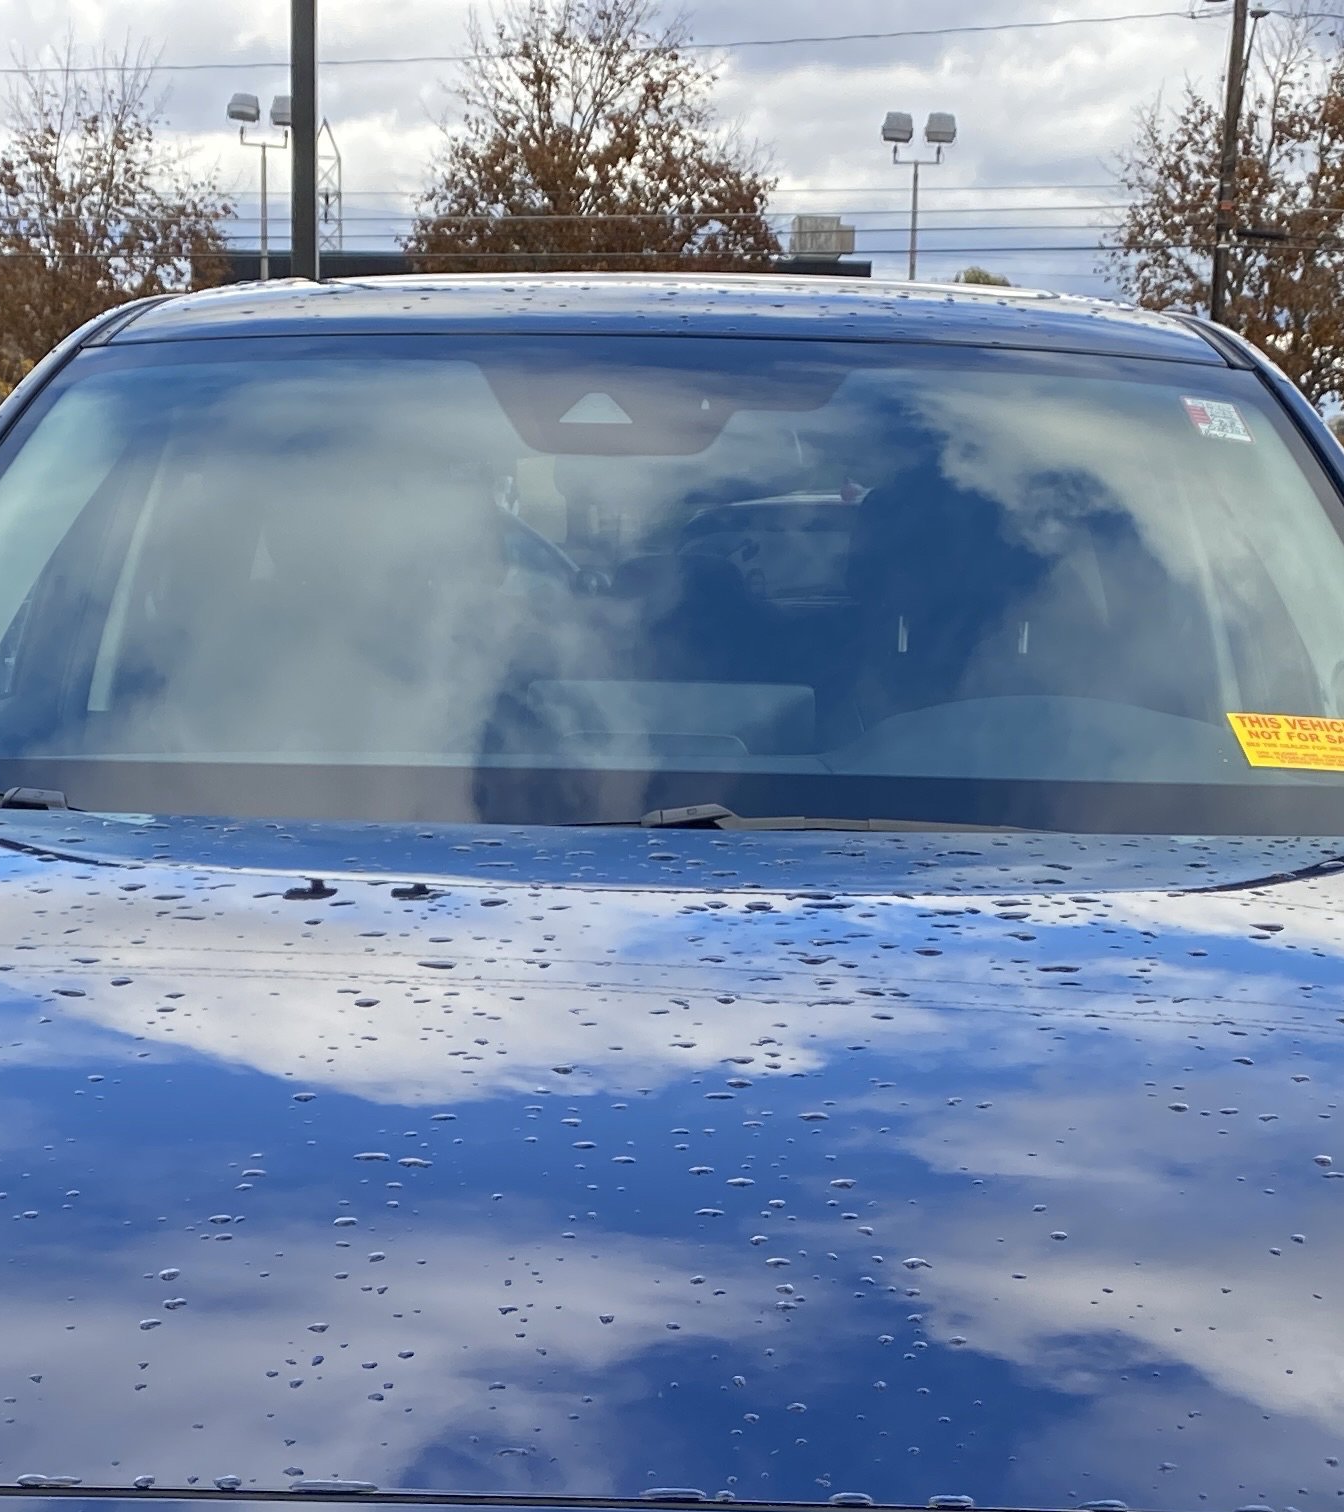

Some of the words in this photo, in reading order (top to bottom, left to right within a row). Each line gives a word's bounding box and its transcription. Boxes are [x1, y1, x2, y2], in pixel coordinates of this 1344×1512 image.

[1235, 715, 1282, 729] THIS
[1248, 730, 1281, 740] NOT
[1286, 731, 1321, 743] FOR
